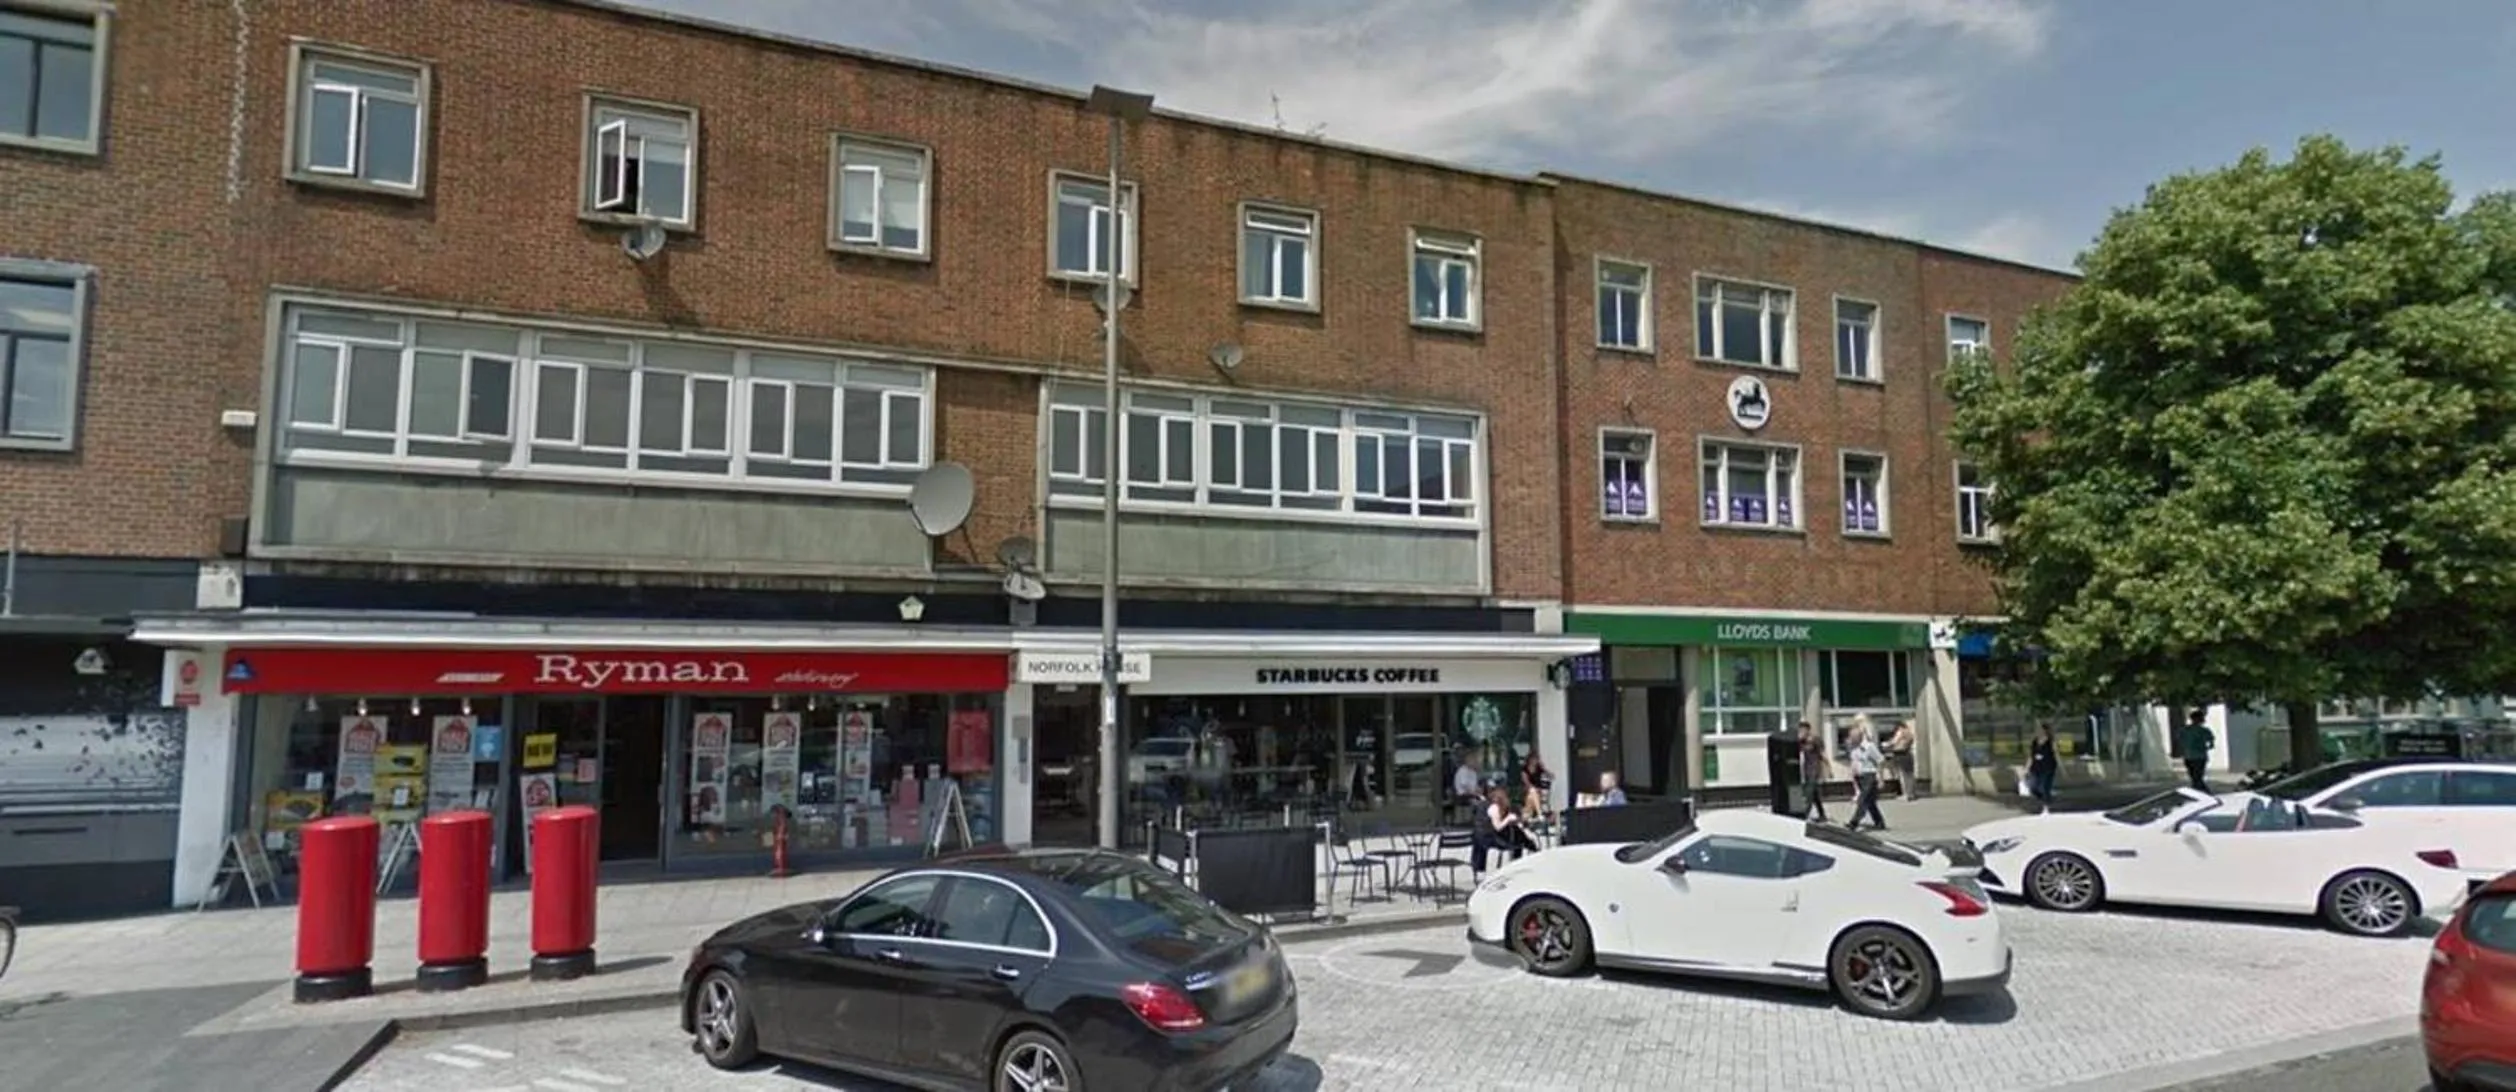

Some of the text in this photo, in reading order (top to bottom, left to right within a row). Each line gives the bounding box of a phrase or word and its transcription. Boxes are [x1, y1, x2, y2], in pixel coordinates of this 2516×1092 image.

[1717, 624, 1812, 640] LLOYDS BANK
[534, 654, 750, 689] Ryman
[1027, 660, 1093, 674] NORFOLK
[1256, 668, 1439, 684] STARBUCKS COFFEE
